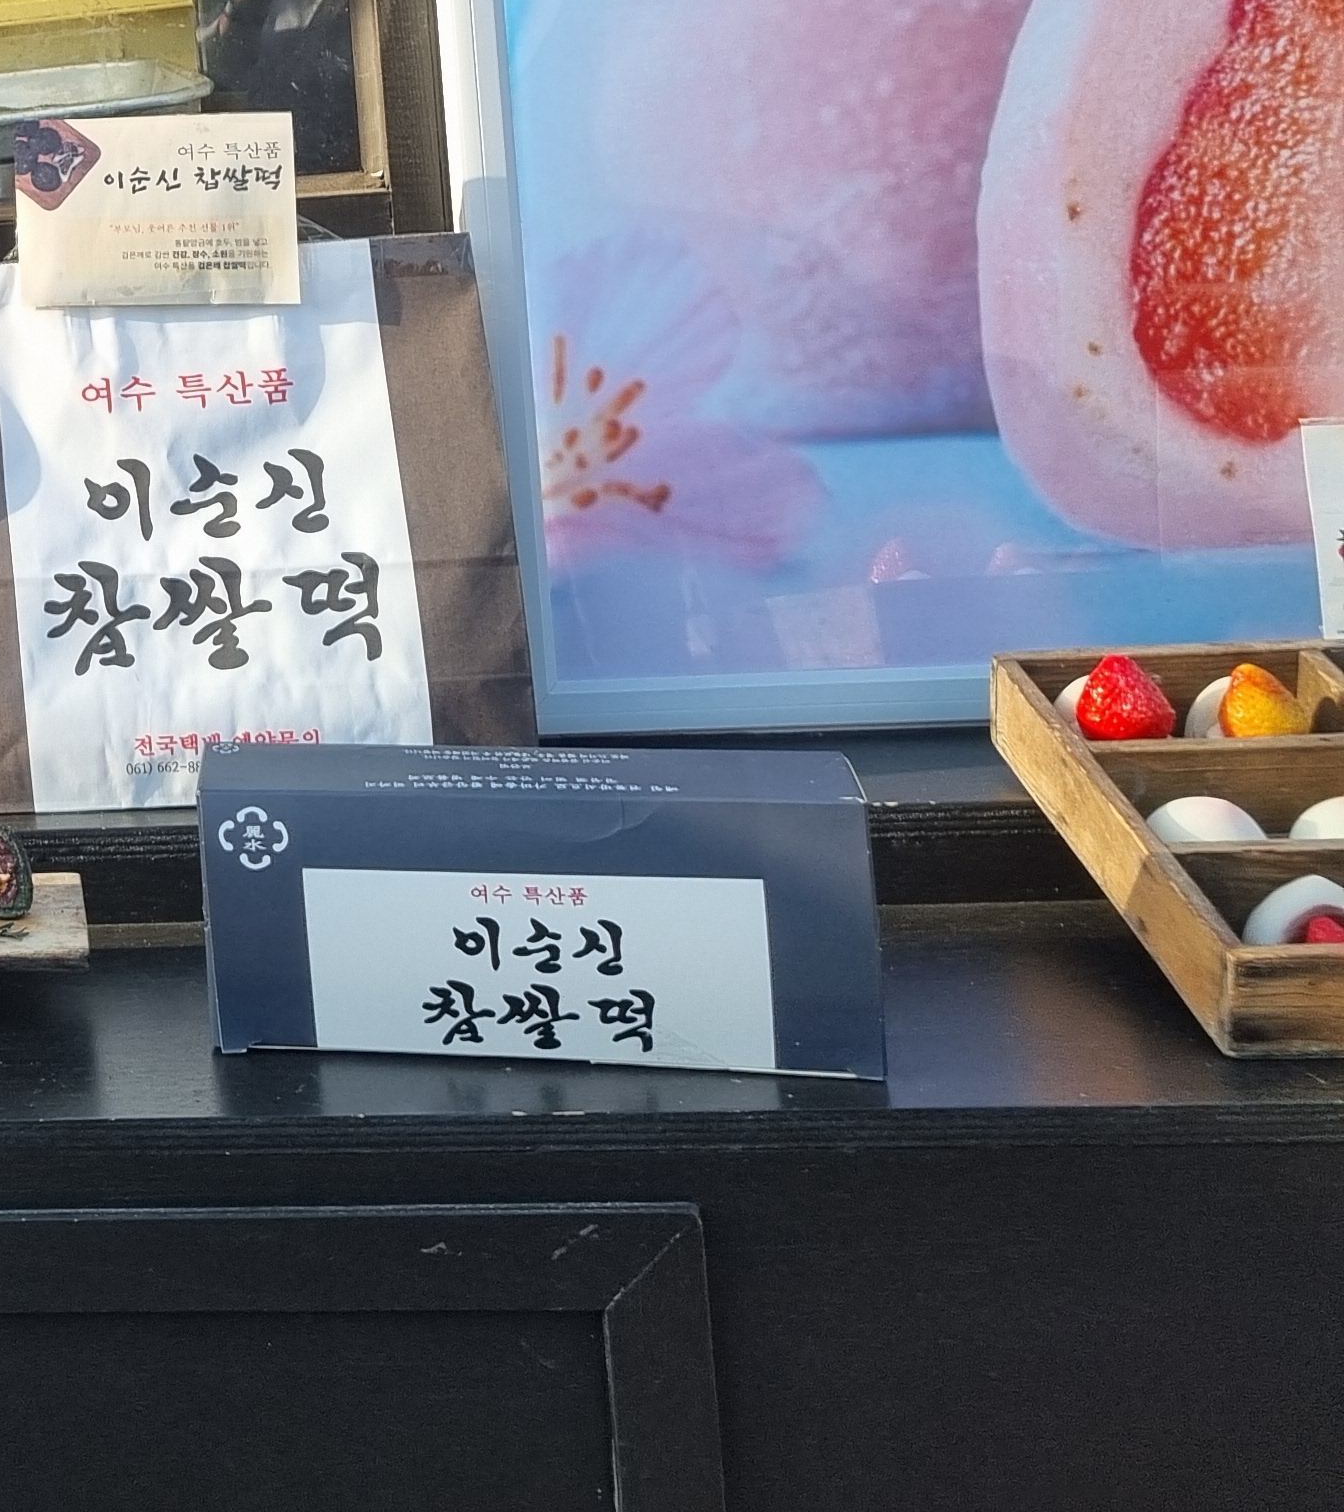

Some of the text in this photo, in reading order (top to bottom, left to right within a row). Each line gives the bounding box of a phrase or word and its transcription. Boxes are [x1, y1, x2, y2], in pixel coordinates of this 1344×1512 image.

[177, 141, 282, 161] 여수 특산품
[104, 164, 283, 194] 이순신 찹쌀떡
[81, 368, 294, 414] 여수 특산품
[83, 448, 332, 541] 이순신
[43, 550, 387, 677] 찹쌀떡
[126, 761, 152, 775] 061)
[471, 884, 589, 908] 여수 특산품
[452, 916, 624, 976] 이순신
[421, 979, 655, 1053] 찹쌀떡
